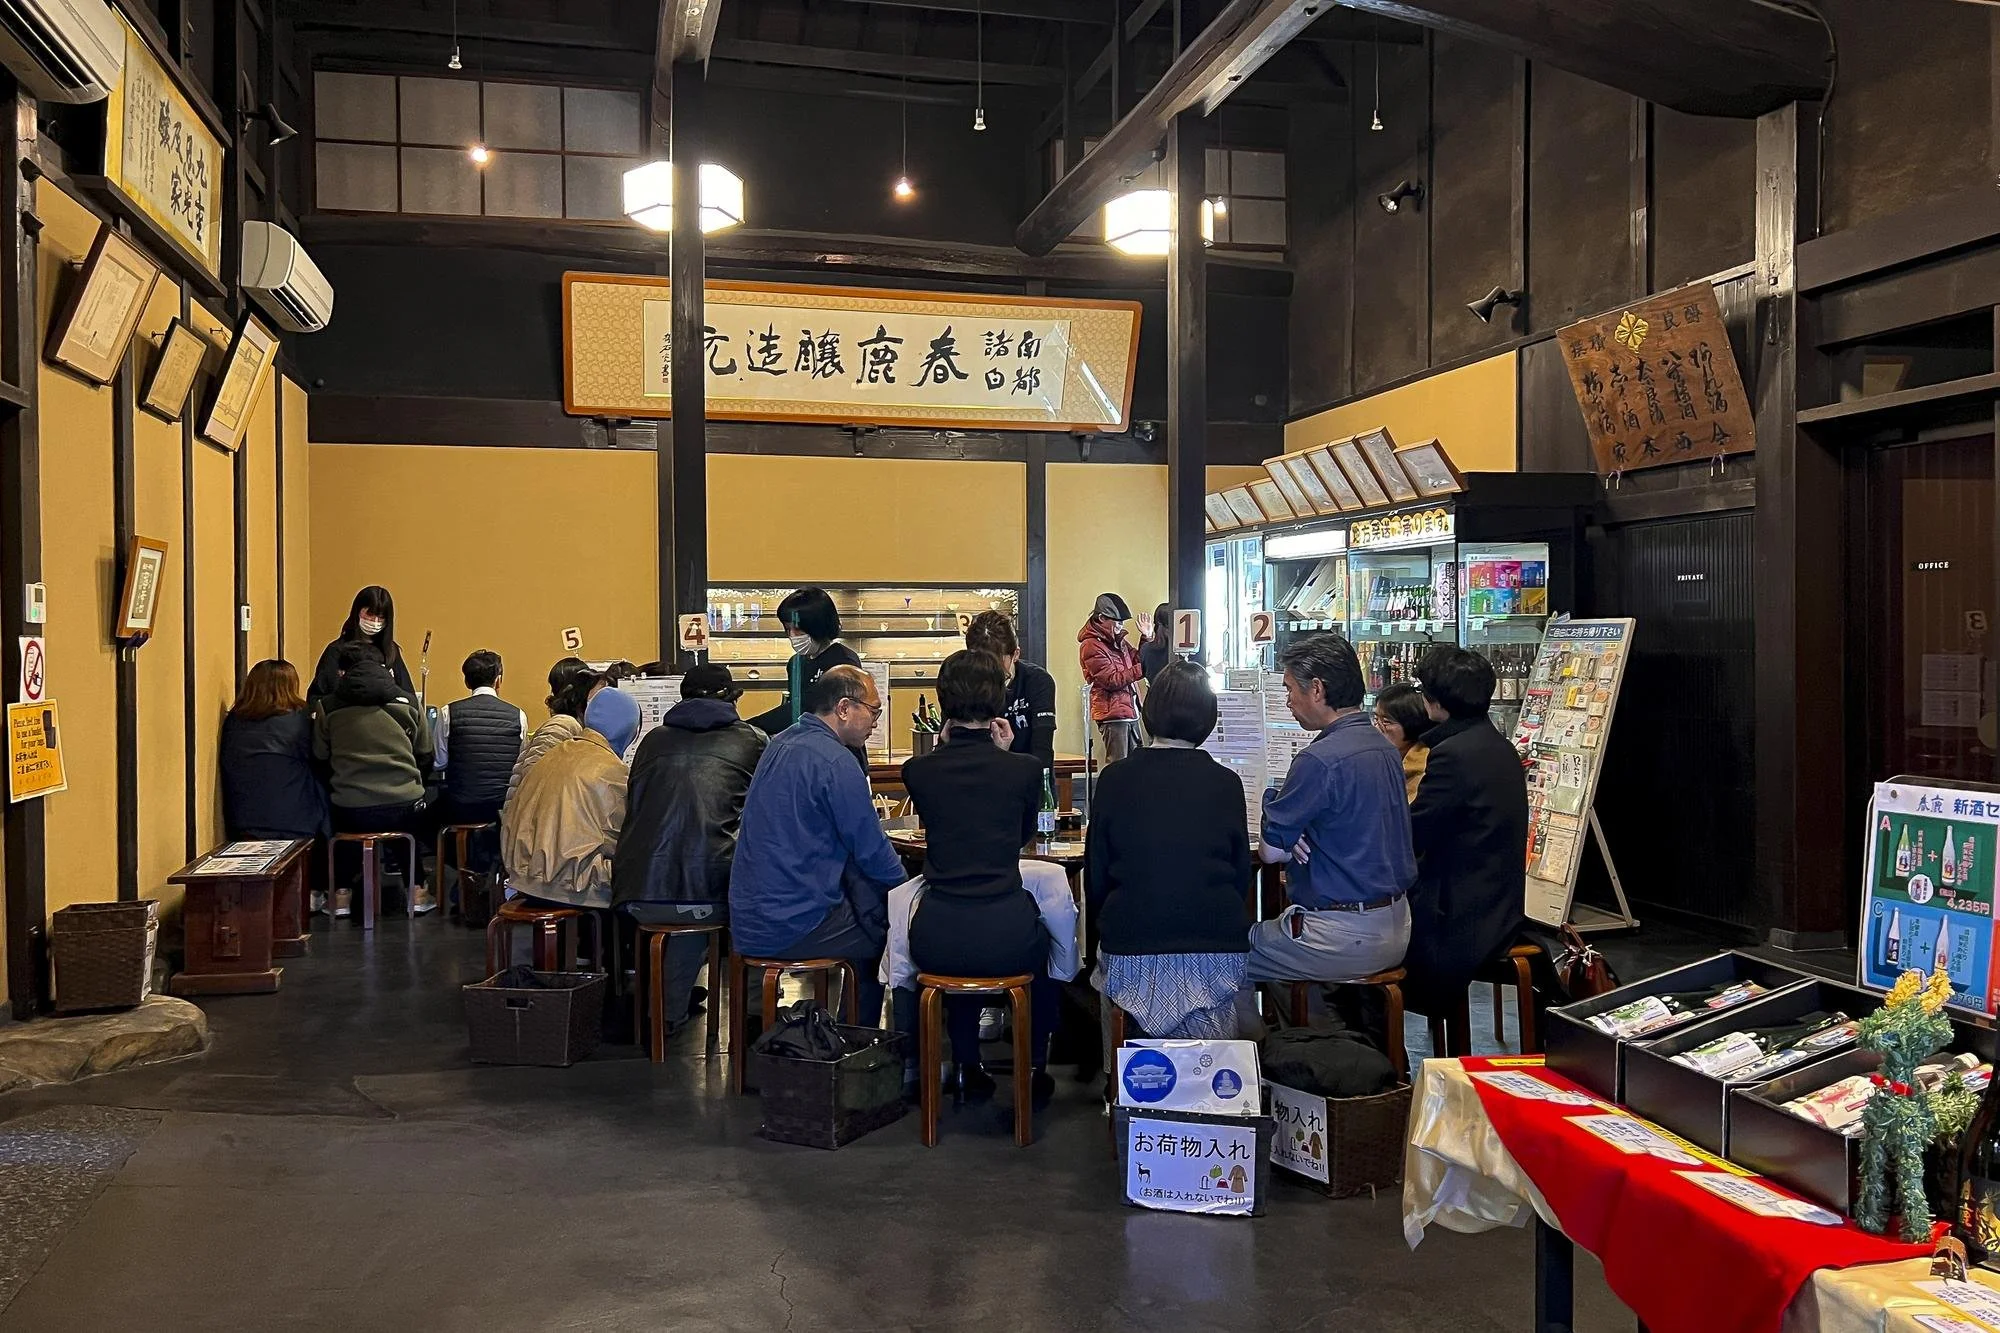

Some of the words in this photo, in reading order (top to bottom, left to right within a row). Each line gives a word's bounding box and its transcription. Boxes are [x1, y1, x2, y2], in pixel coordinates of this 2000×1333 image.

[1917, 561, 1950, 570] OFFICE
[1677, 573, 1704, 581] PRIVATE
[684, 617, 706, 646] 4
[1178, 613, 1195, 648] 1
[1253, 614, 1271, 642] 2
[1548, 627, 1621, 638] ご自由にお持ち帰り下さい
[565, 629, 579, 649] 5
[1953, 799, 2000, 818] 新酒セ
[1880, 815, 1891, 831] A
[1873, 901, 1883, 916] C
[1134, 1131, 1251, 1160] お荷物入れ
